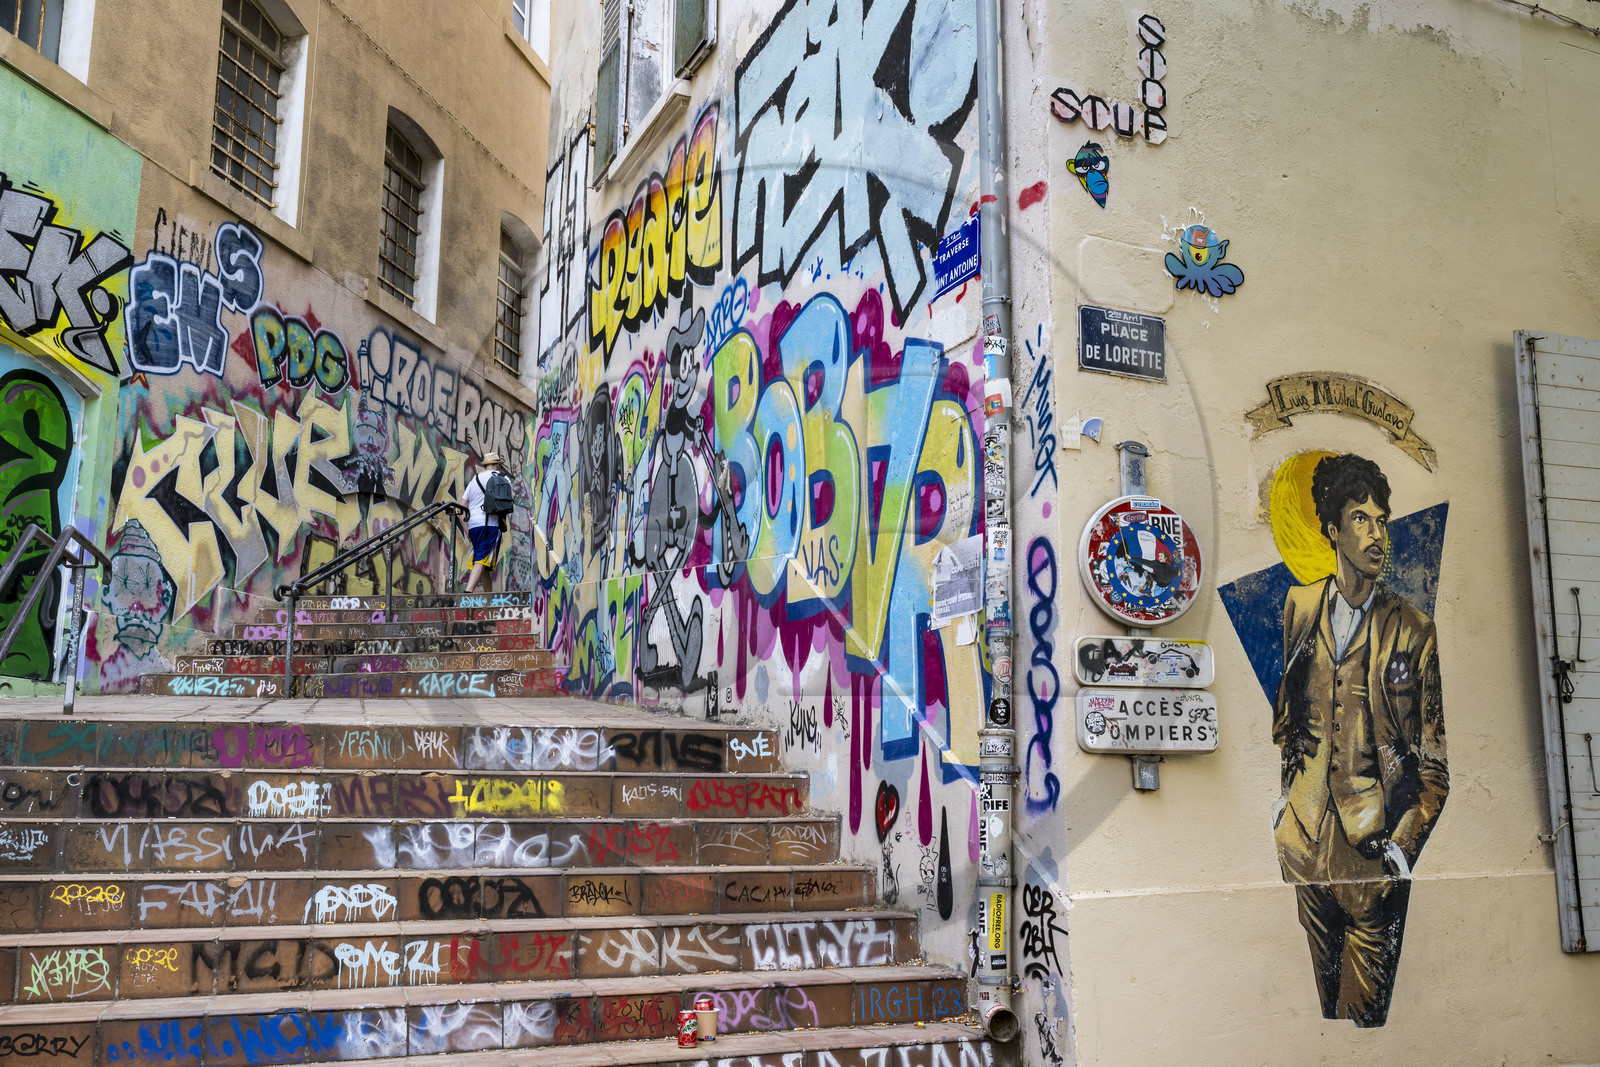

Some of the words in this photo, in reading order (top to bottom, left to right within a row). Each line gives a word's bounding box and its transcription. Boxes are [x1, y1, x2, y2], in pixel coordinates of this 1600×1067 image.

[939, 237, 970, 264] TRAVERSE
[949, 254, 978, 281] ANTOINE
[1101, 323, 1149, 342] PLACE
[1086, 344, 1101, 360] DE
[1105, 344, 1162, 370] LORETTE
[1361, 389, 1405, 431] Gustavo
[1119, 697, 1183, 717] ACCÈS
[1110, 724, 1207, 741] OMPIERS
[994, 894, 1003, 949] RADIOFREE.ORG
[937, 988, 962, 1016] 23
